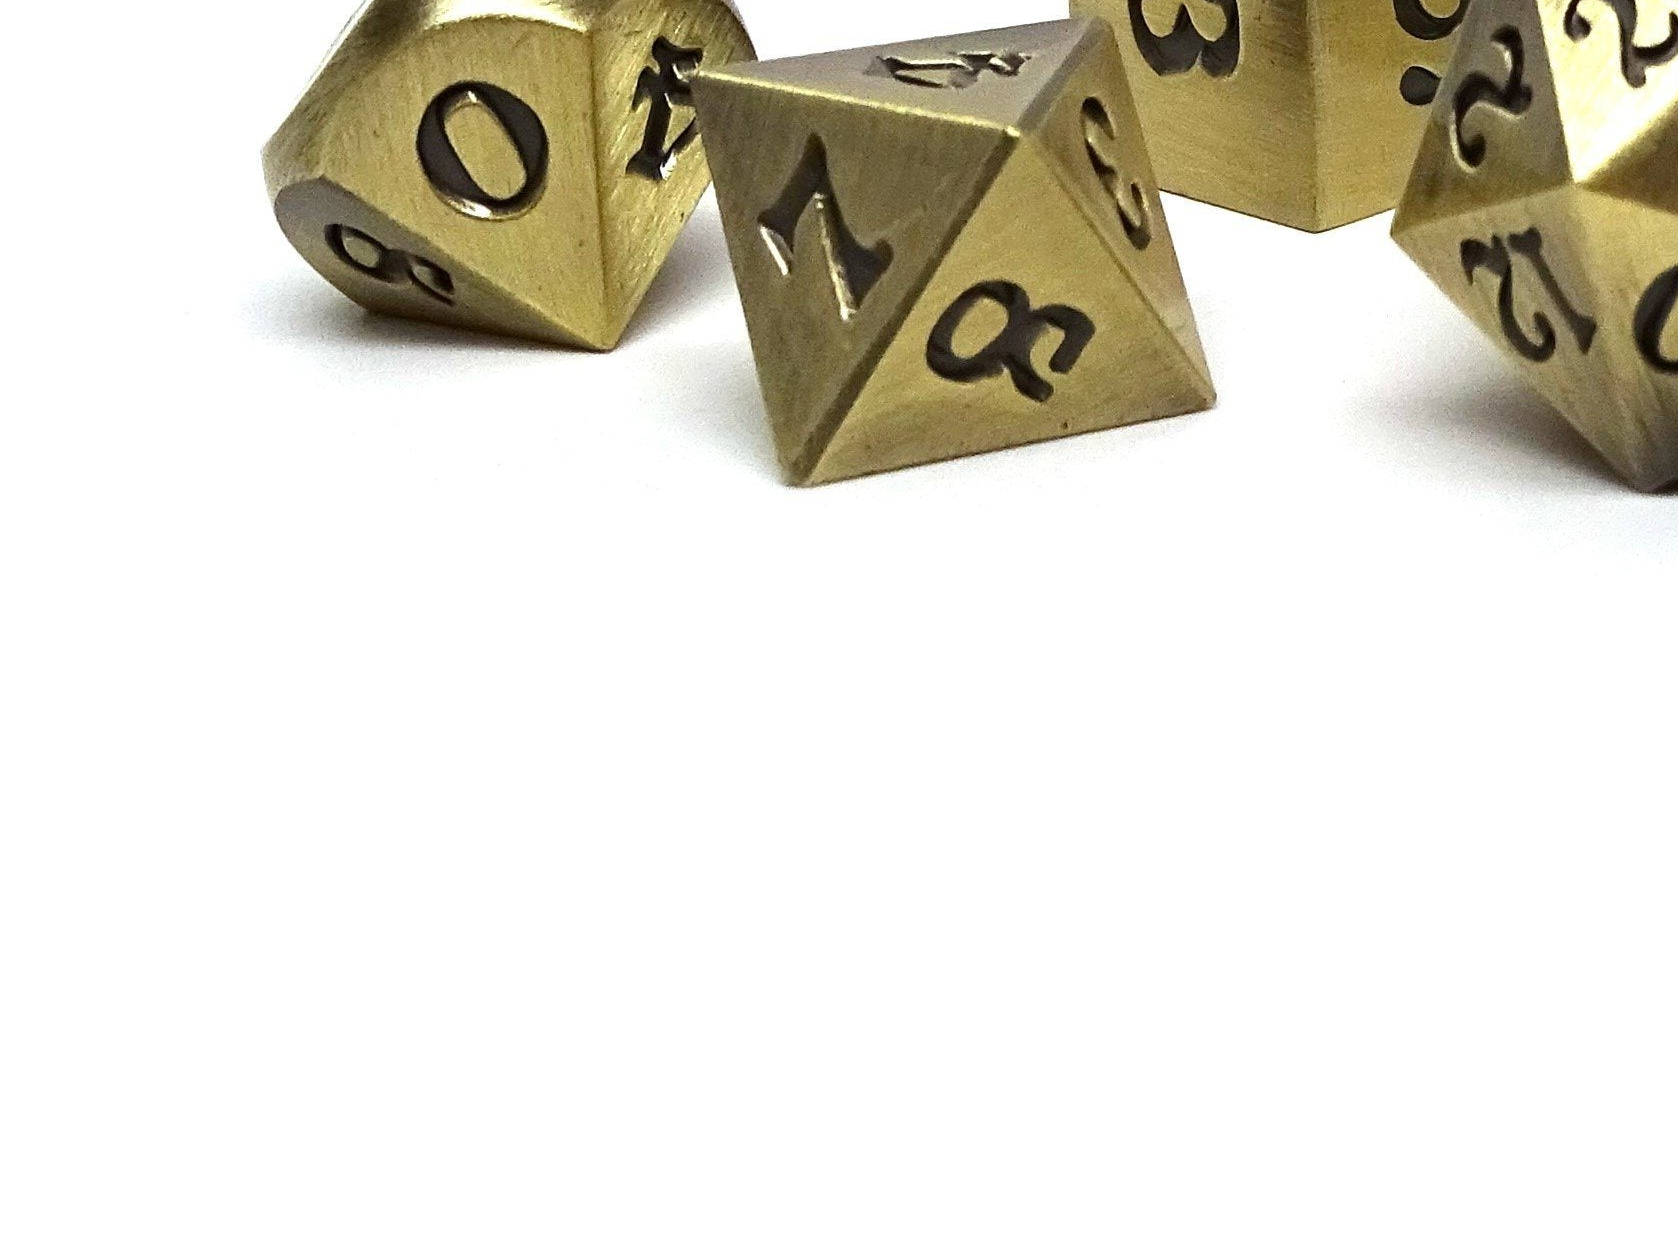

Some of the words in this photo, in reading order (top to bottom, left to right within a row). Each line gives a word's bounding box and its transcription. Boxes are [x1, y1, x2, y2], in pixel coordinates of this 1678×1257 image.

[415, 80, 550, 222] 0
[1450, 23, 1533, 173] 2
[926, 279, 1096, 404] 8
[1459, 226, 1597, 364] 12
